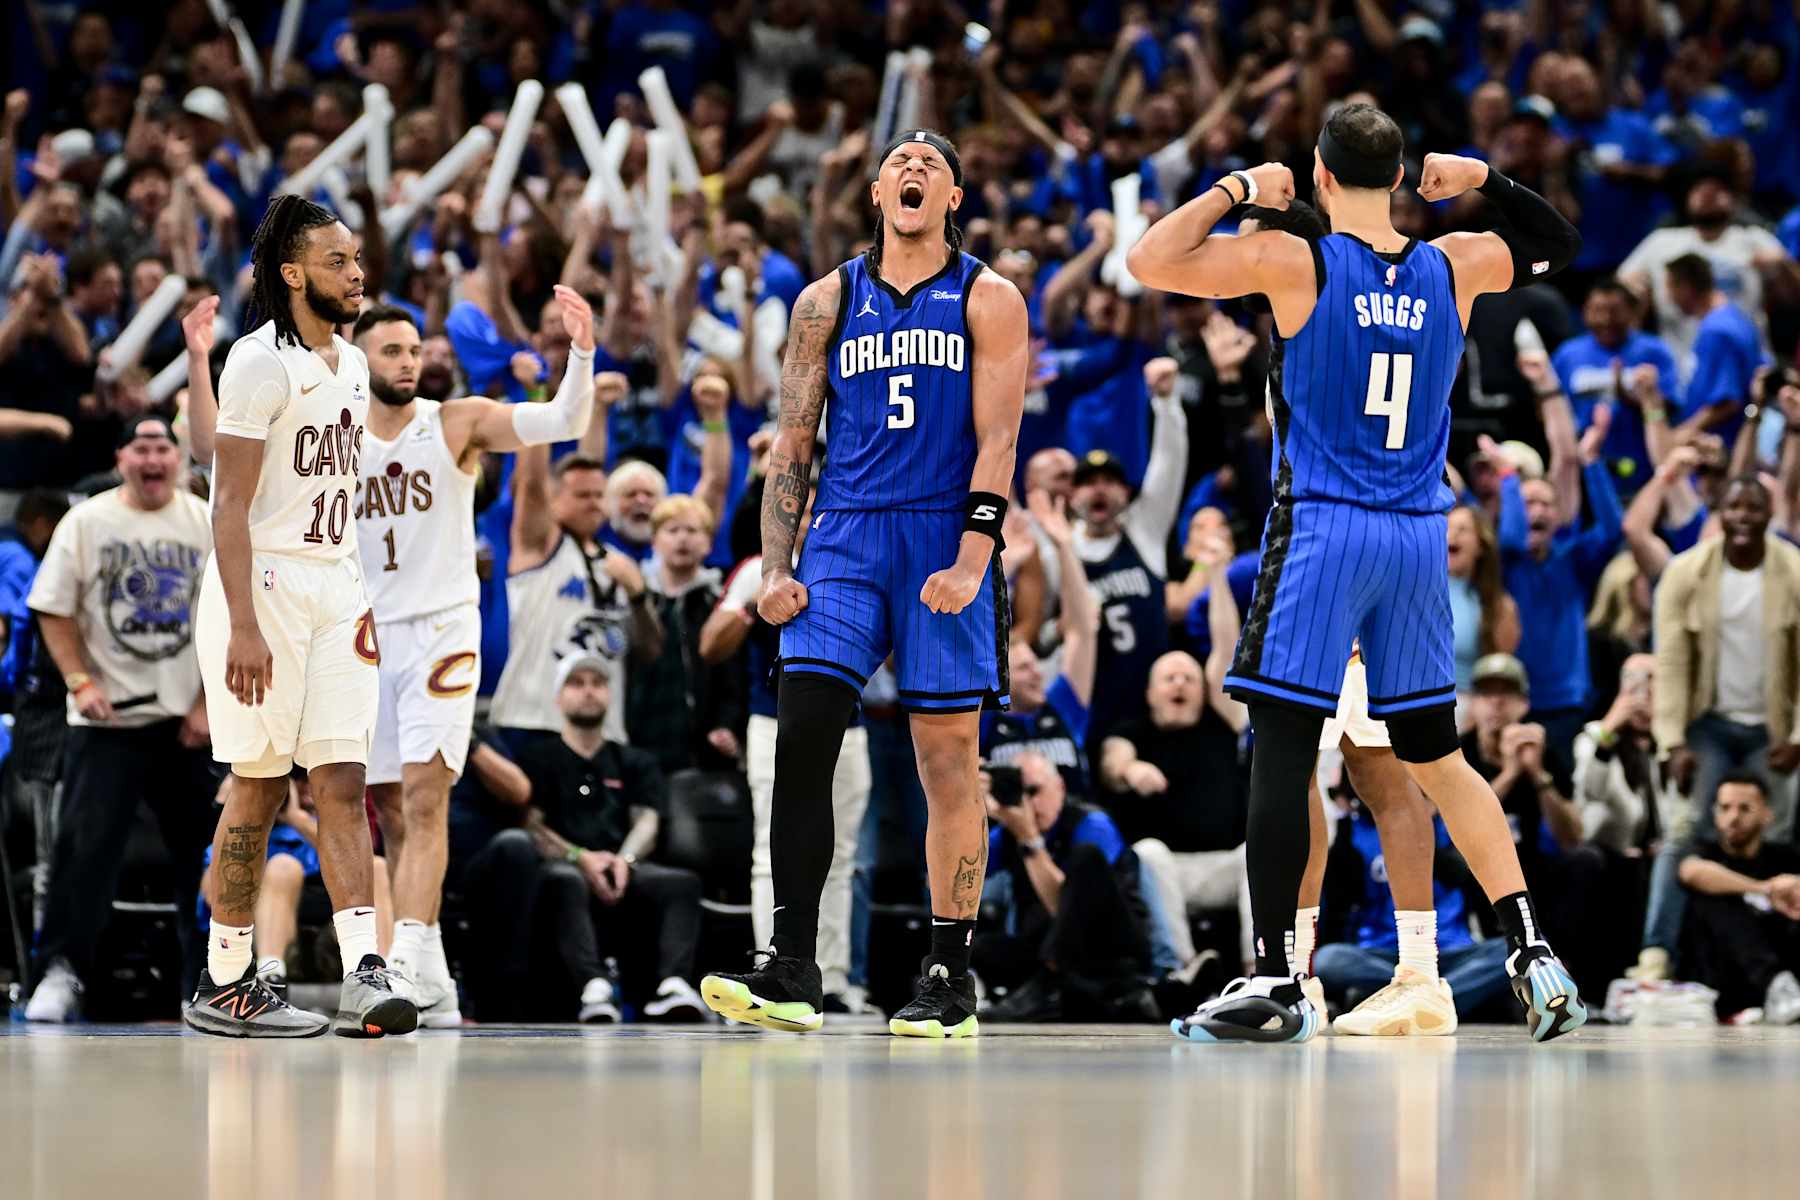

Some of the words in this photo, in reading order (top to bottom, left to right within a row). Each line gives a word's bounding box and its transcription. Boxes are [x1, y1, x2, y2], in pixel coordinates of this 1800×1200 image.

[930, 289, 961, 302] Disney
[1353, 291, 1427, 332] SUGGS
[840, 328, 965, 379] ORLANDO
[887, 373, 915, 430] 5
[1364, 352, 1413, 450] 4
[304, 489, 348, 545] 10
[971, 504, 998, 521] 5
[383, 526, 399, 571] 1
[1104, 603, 1136, 653] 5
[426, 650, 477, 699] C
